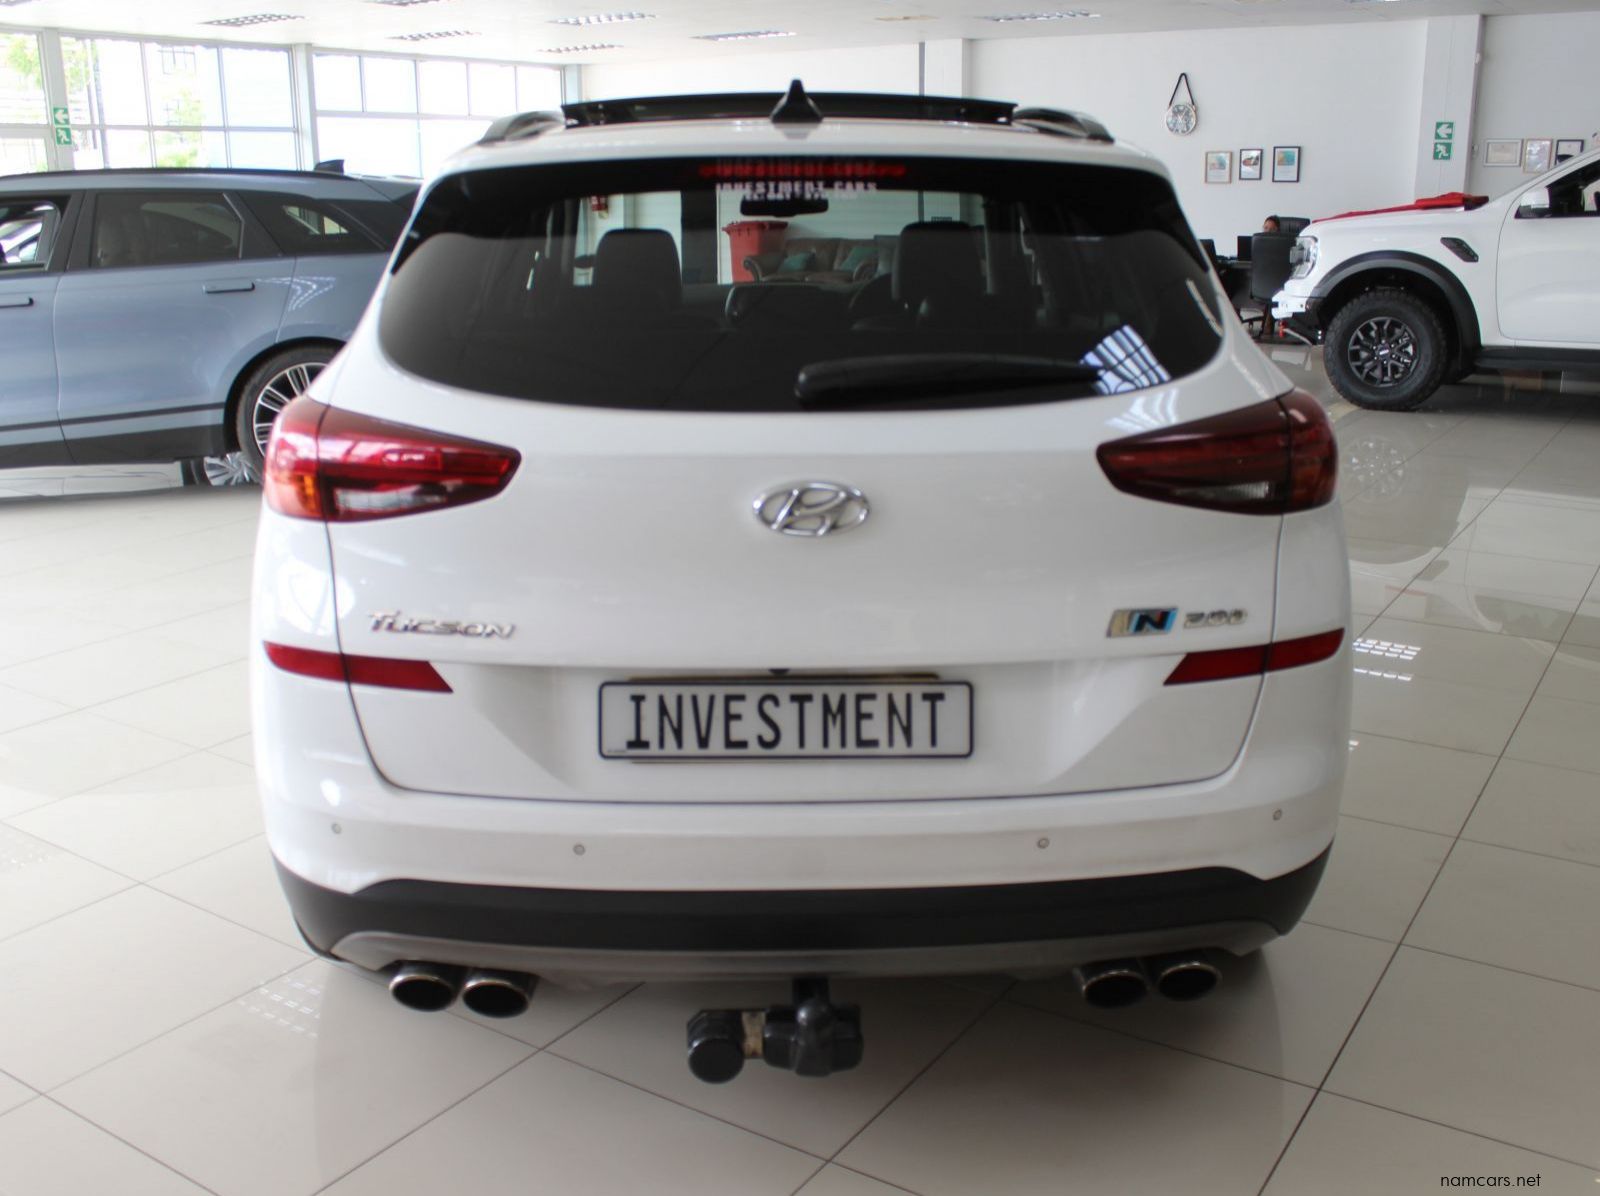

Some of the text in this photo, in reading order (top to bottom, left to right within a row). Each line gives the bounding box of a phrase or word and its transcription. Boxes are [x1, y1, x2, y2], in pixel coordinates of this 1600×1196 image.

[833, 181, 878, 193] CARS
[368, 610, 516, 639] TUCSON
[626, 692, 945, 749] INVESTMENT
